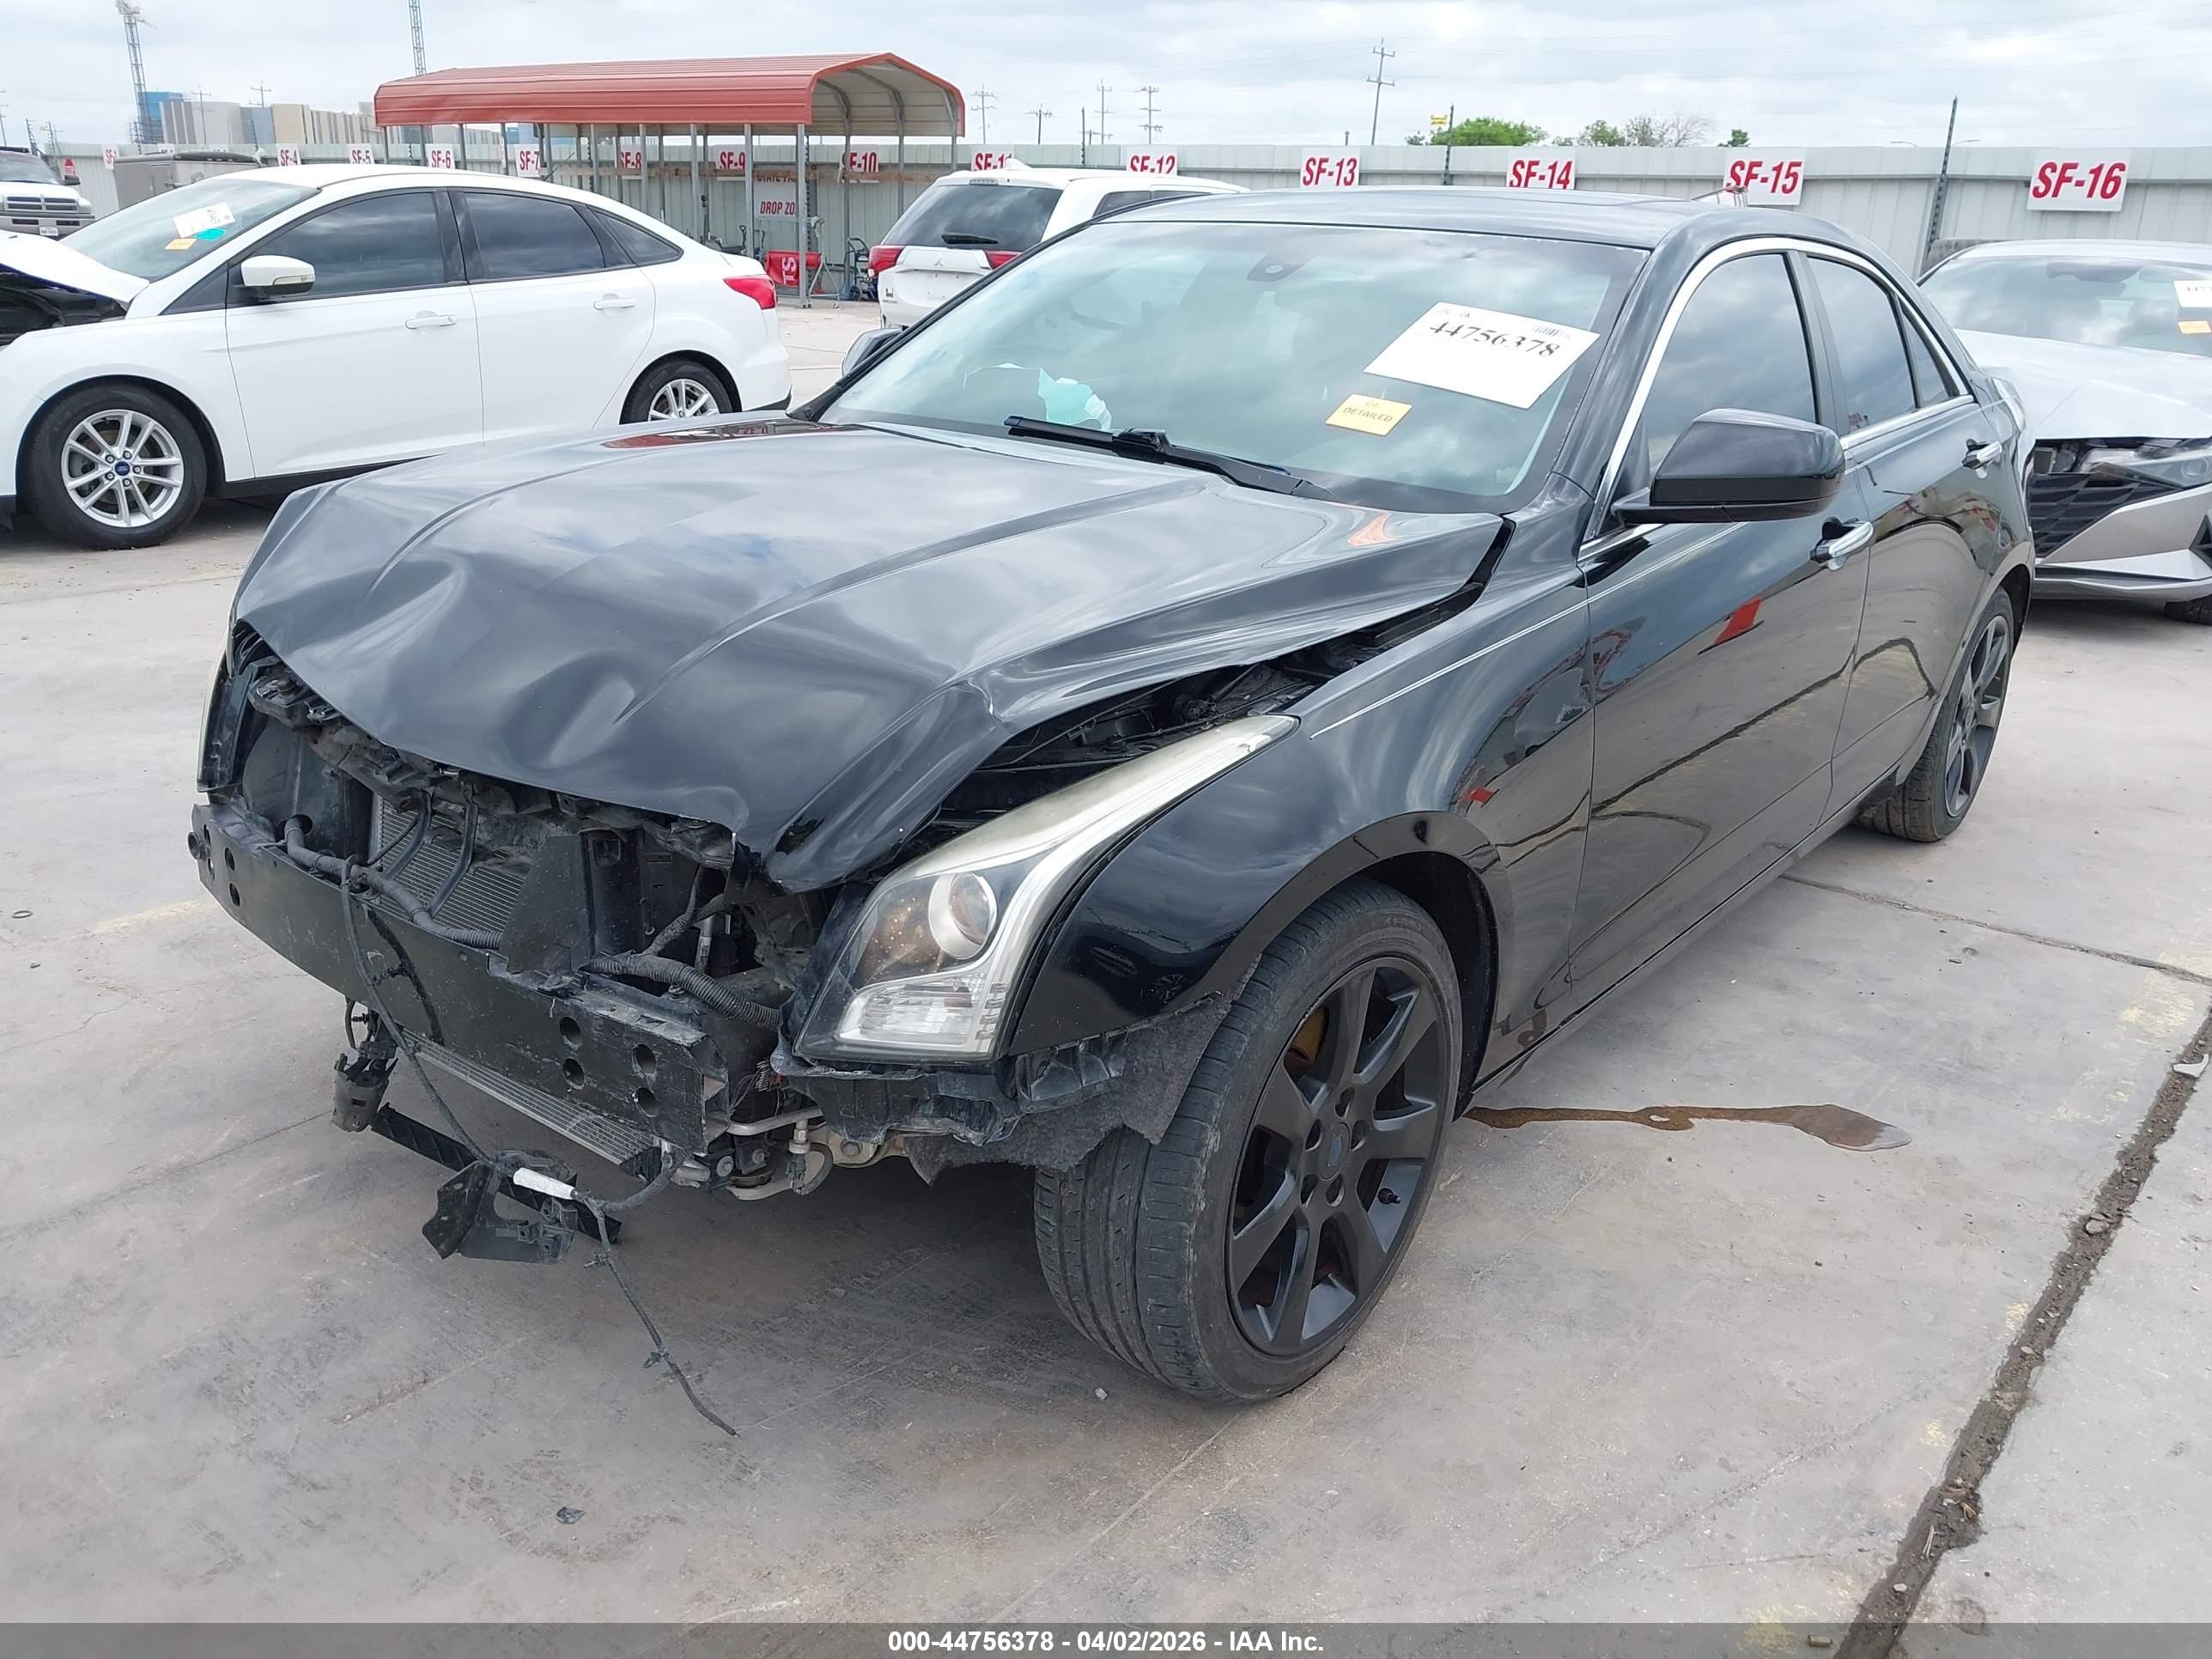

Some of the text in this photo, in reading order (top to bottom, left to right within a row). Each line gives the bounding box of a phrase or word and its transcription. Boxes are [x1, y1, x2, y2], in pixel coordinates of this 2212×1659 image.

[280, 149, 298, 166] SF-4
[352, 149, 371, 164] SF-5
[431, 150, 451, 167] SF-6
[520, 150, 539, 170] SF-7
[720, 152, 745, 170] SF-9
[849, 152, 877, 173] F-10
[975, 153, 1012, 170] SF-1
[1130, 155, 1176, 174] SF-12
[1303, 157, 1357, 186] SF-13
[1510, 160, 1572, 189] SF-14
[1727, 160, 1803, 194] SF-15
[2032, 161, 2126, 199] SF-16
[760, 201, 796, 215] DROP ZO
[1430, 322, 1560, 356] 44756378
[1342, 407, 1393, 422] DETAILED
